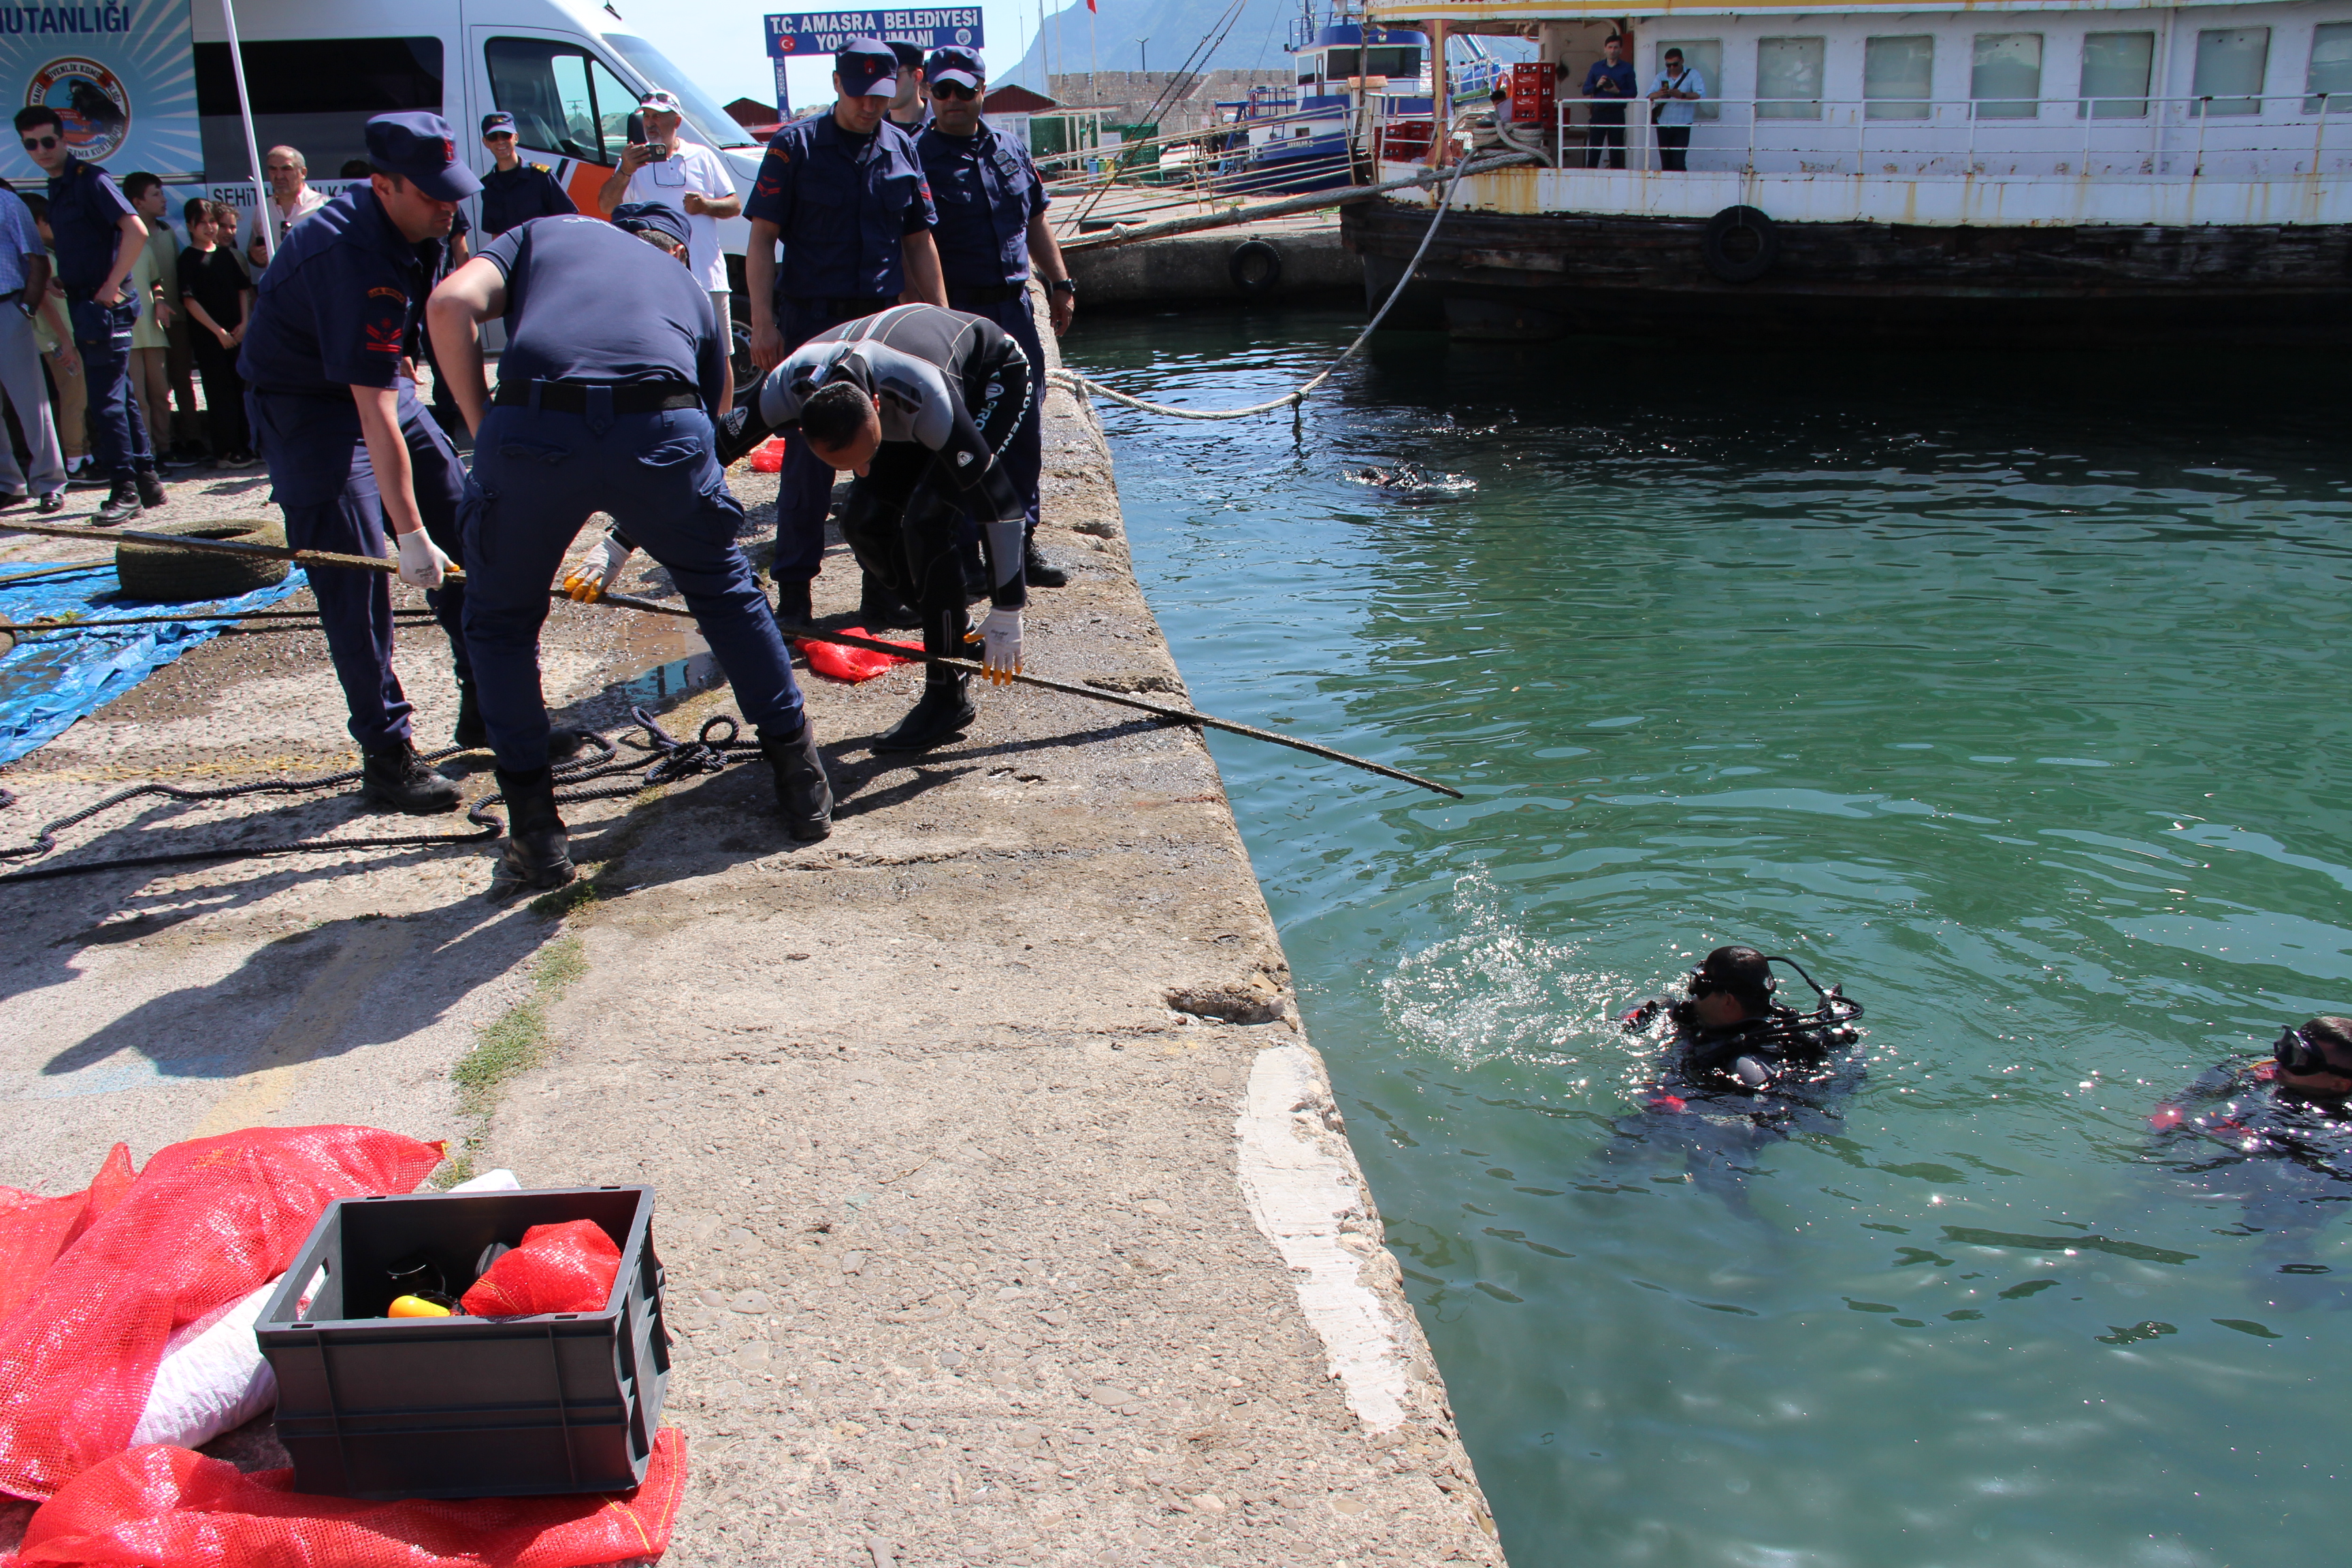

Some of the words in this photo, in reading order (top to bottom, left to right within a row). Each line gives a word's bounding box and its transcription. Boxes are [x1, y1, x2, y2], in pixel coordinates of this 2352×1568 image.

[0, 0, 130, 34] UTANLIĞI
[770, 16, 798, 34] T.C.
[801, 13, 877, 33] AMASRA
[996, 381, 1033, 455] GÜVENL
